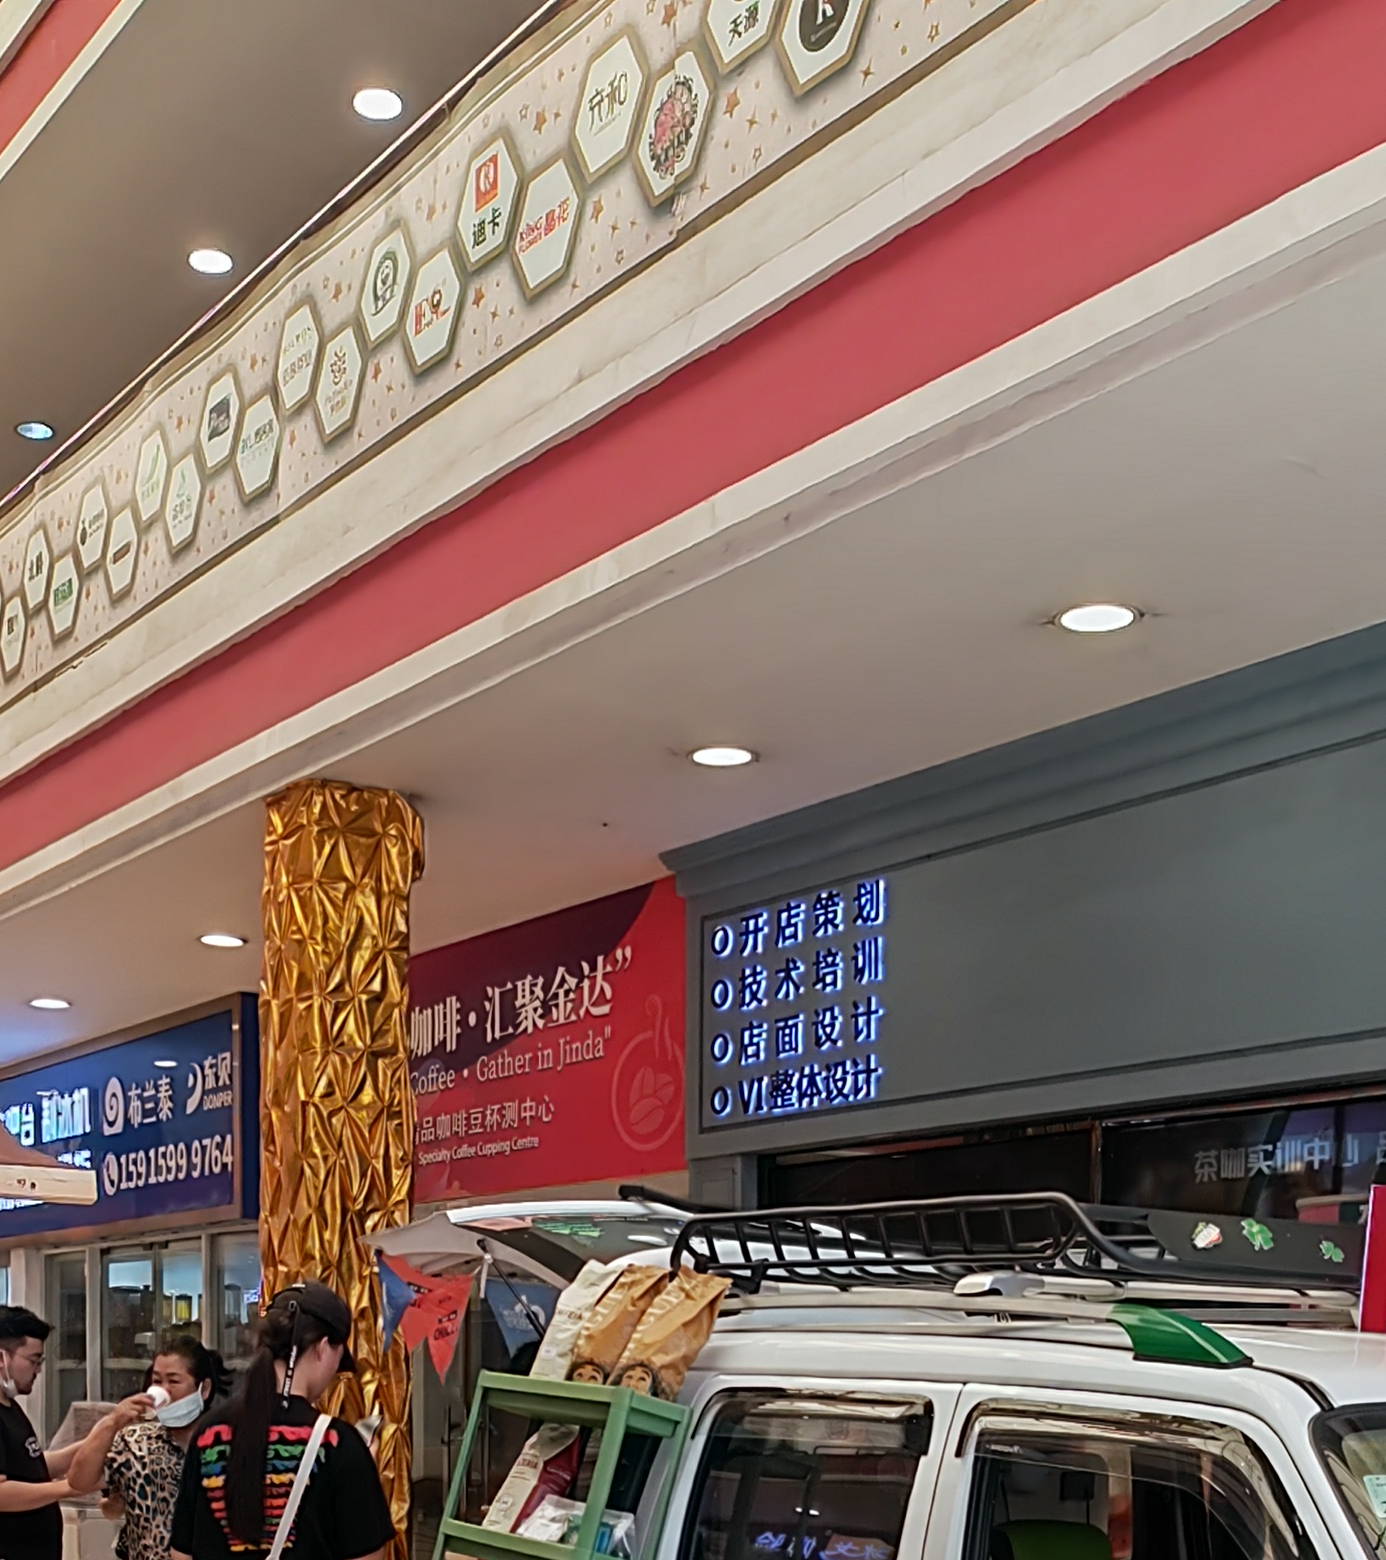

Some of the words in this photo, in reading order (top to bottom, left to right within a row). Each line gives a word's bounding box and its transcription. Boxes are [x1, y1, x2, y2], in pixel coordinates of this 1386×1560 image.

[739, 878, 887, 957] 开店策划
[738, 936, 884, 1011] 技术培训
[738, 996, 884, 1067] 店面设计
[203, 1051, 232, 1091] 东贝
[476, 1047, 532, 1083] Gather
[536, 1042, 554, 1071] in
[738, 1054, 882, 1116] VI整体设计
[127, 1074, 174, 1129] 布兰泰
[191, 1134, 234, 1179] 9764
[418, 1143, 451, 1167] Specialty
[452, 1140, 476, 1160] Coffee
[477, 1137, 510, 1158] Cupping
[512, 1135, 539, 1151] Centre
